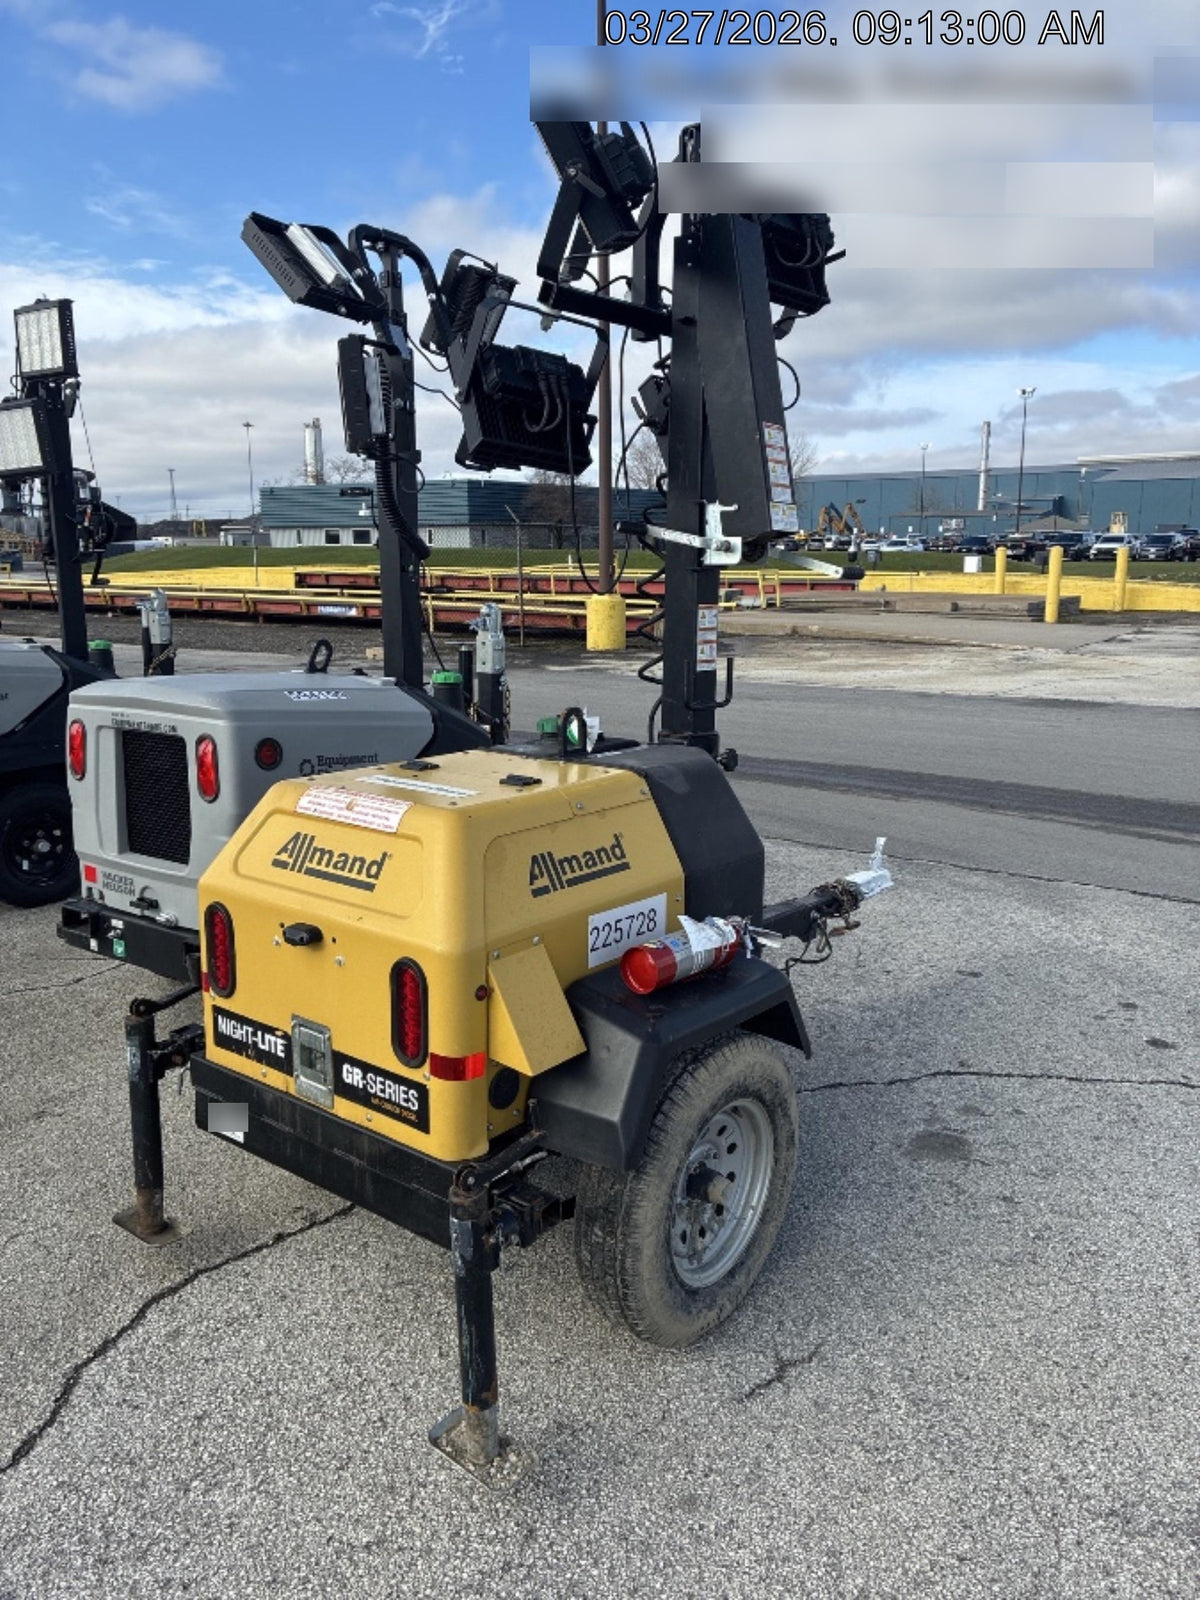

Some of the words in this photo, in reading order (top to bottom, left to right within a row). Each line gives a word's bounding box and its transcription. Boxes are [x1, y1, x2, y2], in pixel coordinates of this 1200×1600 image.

[316, 753, 379, 768] Equipment
[276, 832, 388, 880] Allmand
[529, 832, 627, 891] Allmand
[589, 907, 658, 953] 225728
[217, 1014, 287, 1059] NIGHT-LITE
[342, 1063, 419, 1111] GR-SERIES
